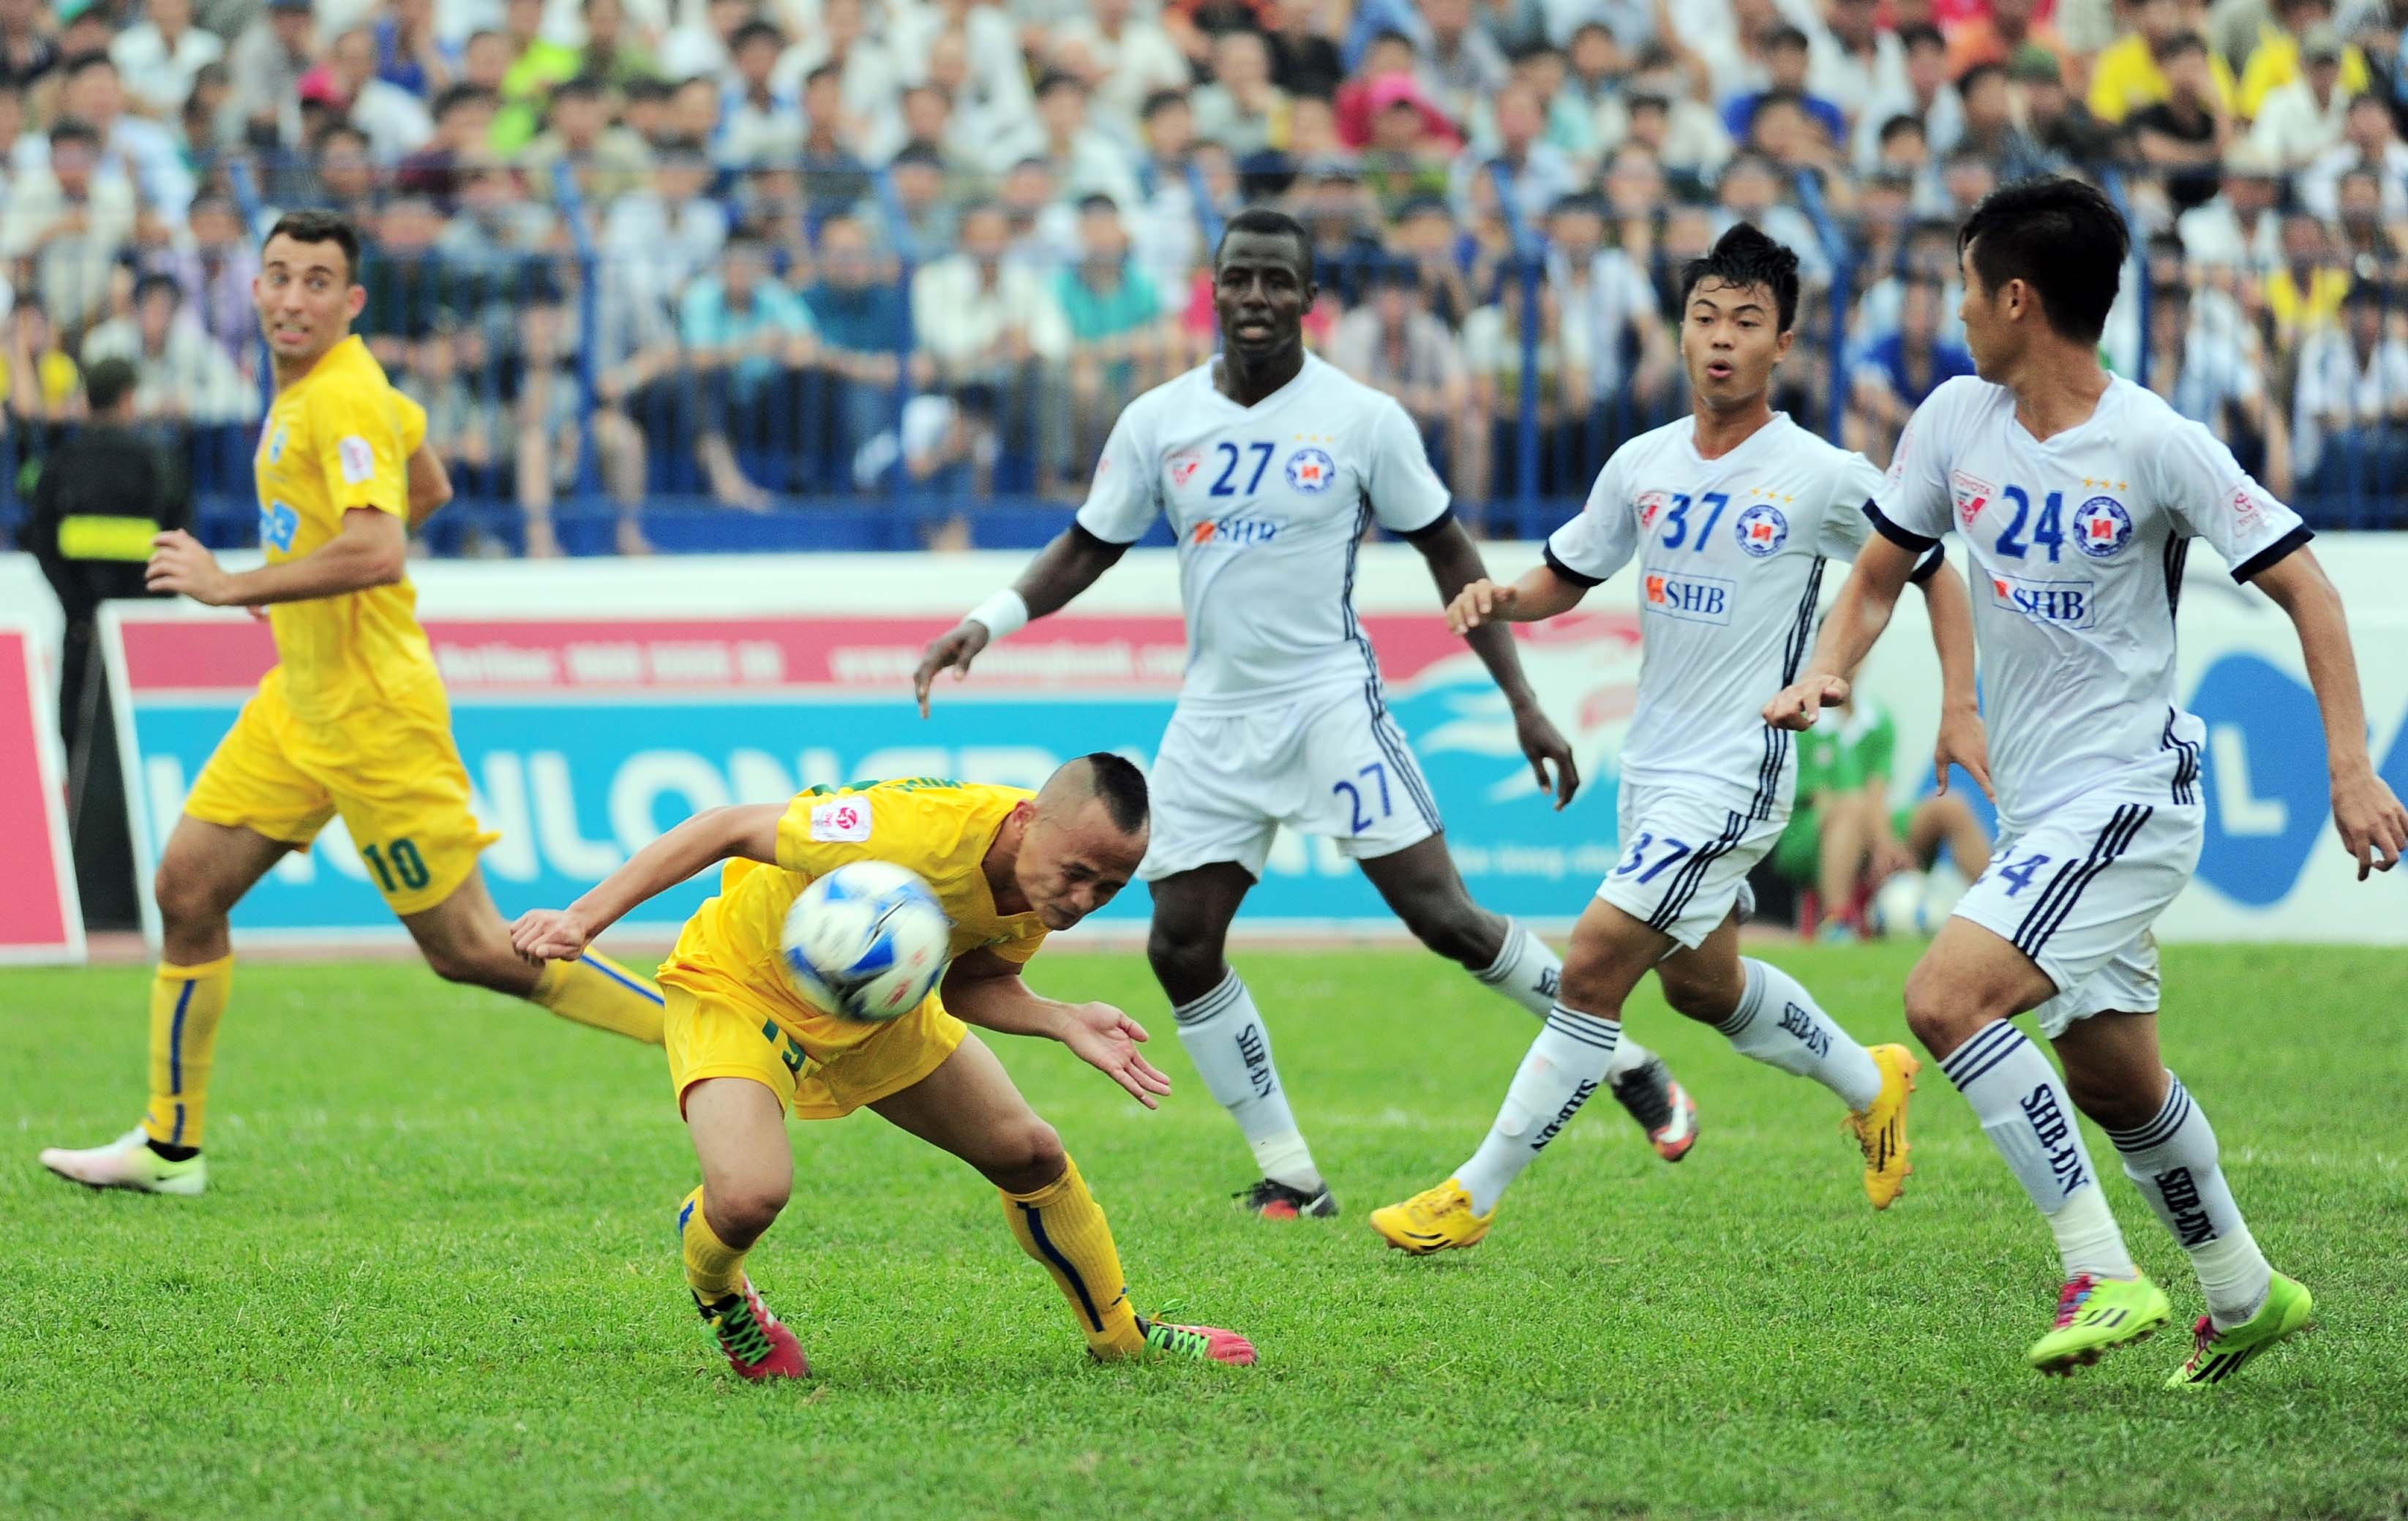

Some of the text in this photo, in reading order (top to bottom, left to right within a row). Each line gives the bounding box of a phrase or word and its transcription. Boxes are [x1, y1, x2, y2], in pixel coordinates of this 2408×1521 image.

[1209, 441, 1275, 497] 27
[1662, 491, 1730, 552] 37
[1995, 484, 2065, 564] 24
[1665, 580, 1725, 615] SHB
[2013, 586, 2085, 620] SHB
[1333, 762, 1392, 835] 27
[363, 836, 431, 892] 10
[1616, 832, 1692, 885] 37
